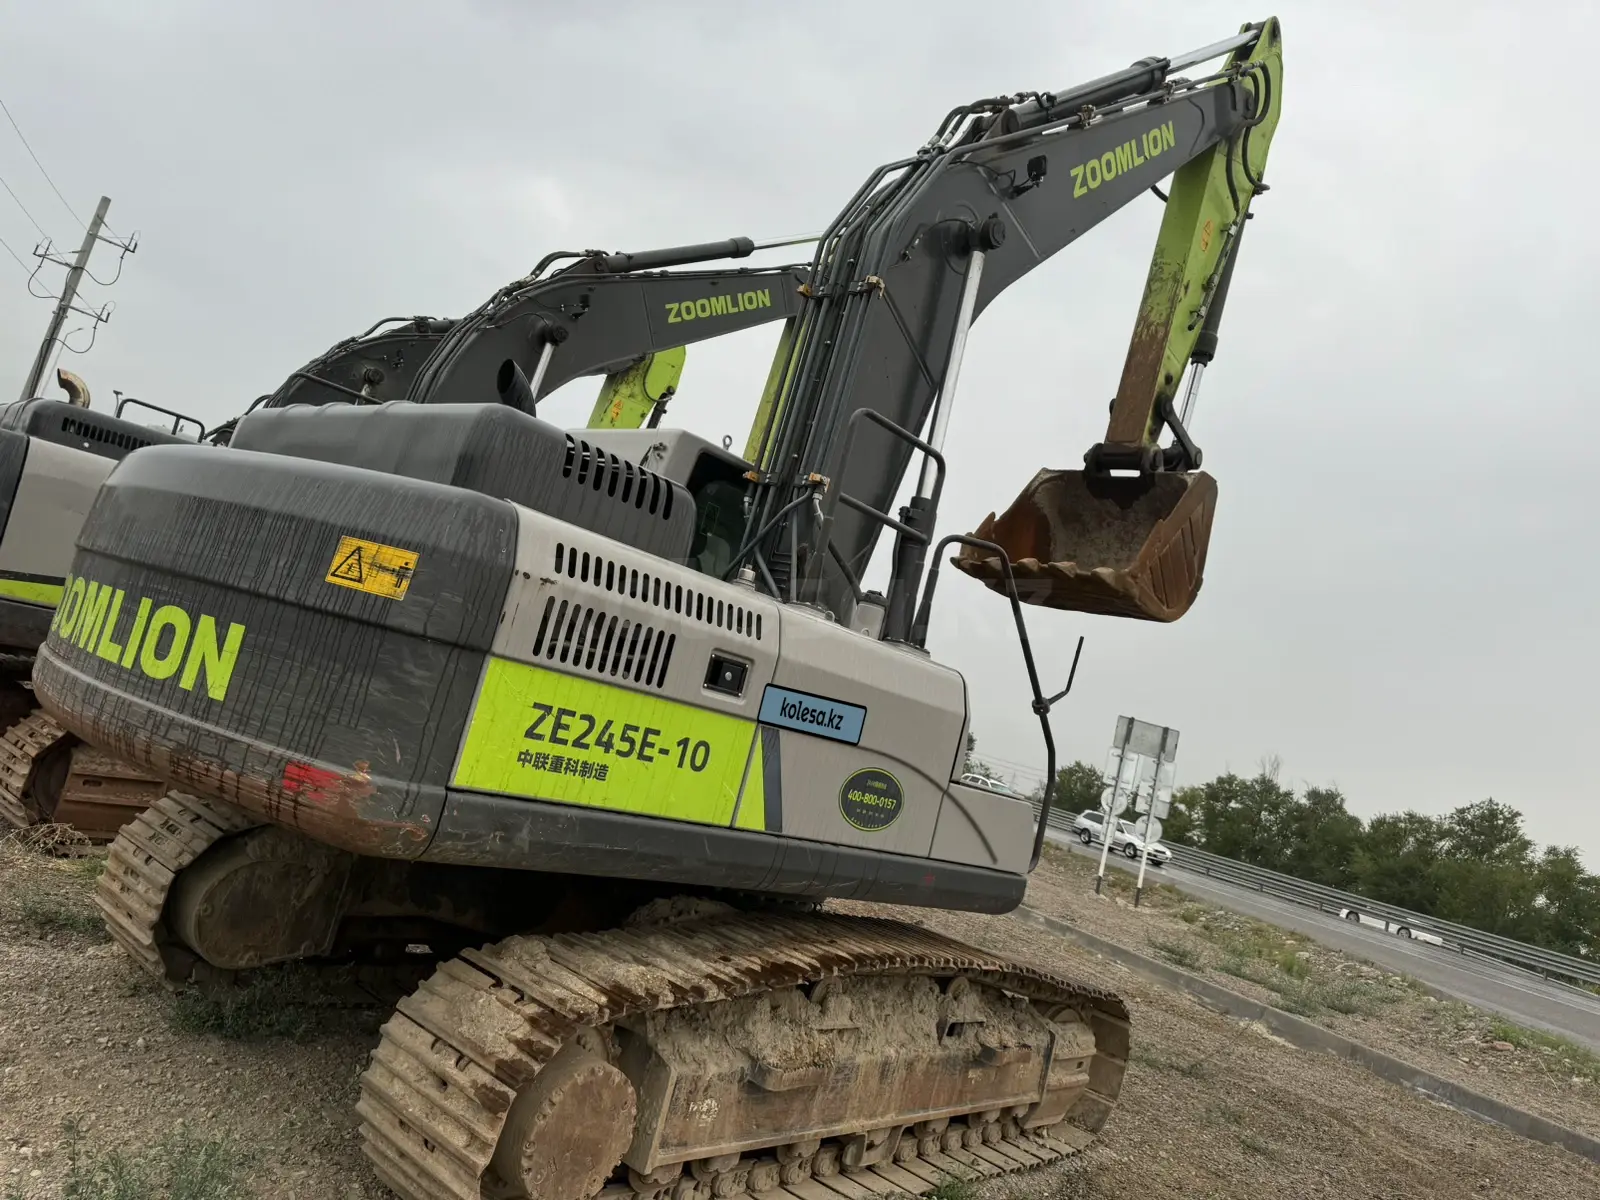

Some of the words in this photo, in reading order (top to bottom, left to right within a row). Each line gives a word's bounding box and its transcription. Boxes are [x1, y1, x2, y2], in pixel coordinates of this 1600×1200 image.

[1070, 120, 1176, 199] ZOOMLION
[665, 288, 771, 324] ZOOMLION
[52, 573, 246, 702] OOMLION
[523, 701, 711, 773] ZE245E-10
[516, 749, 610, 782] 中联重科制造
[848, 789, 896, 810] 400-800-0157
